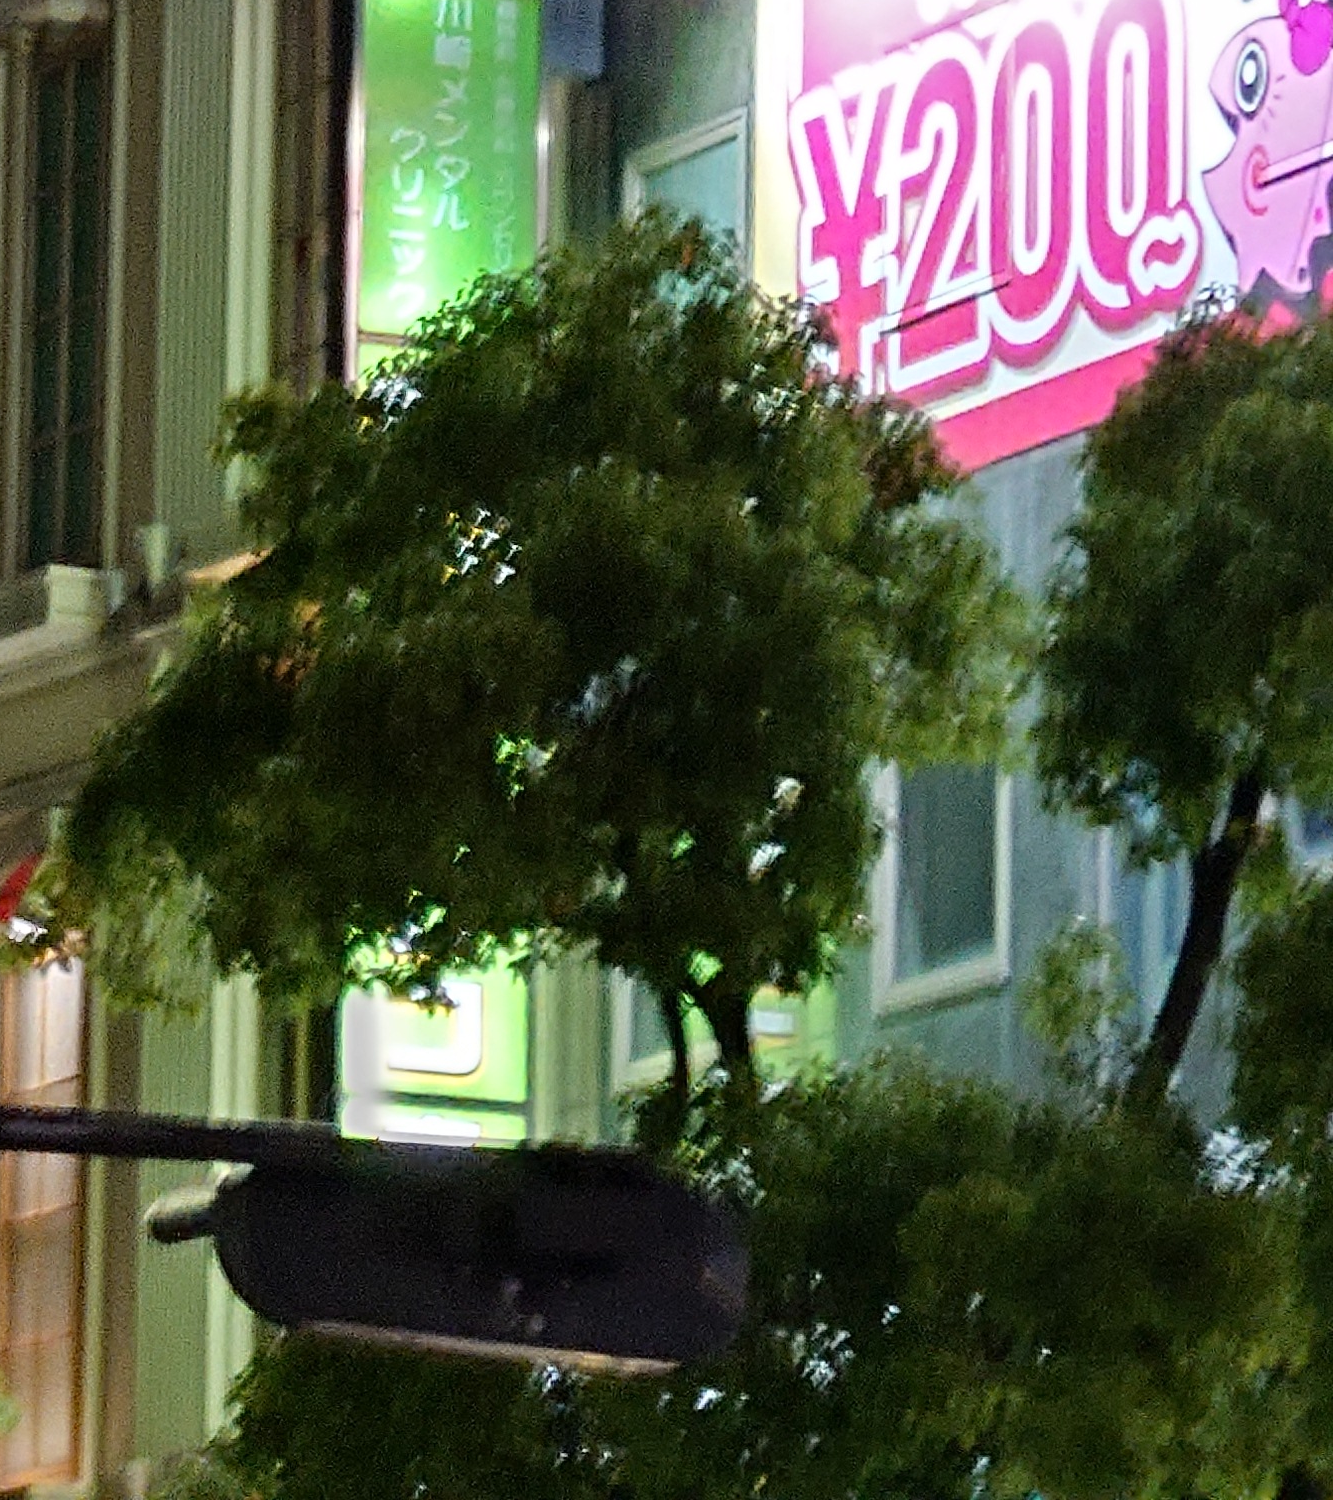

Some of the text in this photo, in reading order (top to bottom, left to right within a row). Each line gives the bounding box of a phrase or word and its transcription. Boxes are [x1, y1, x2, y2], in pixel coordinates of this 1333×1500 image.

[388, 126, 428, 319] クリニック
